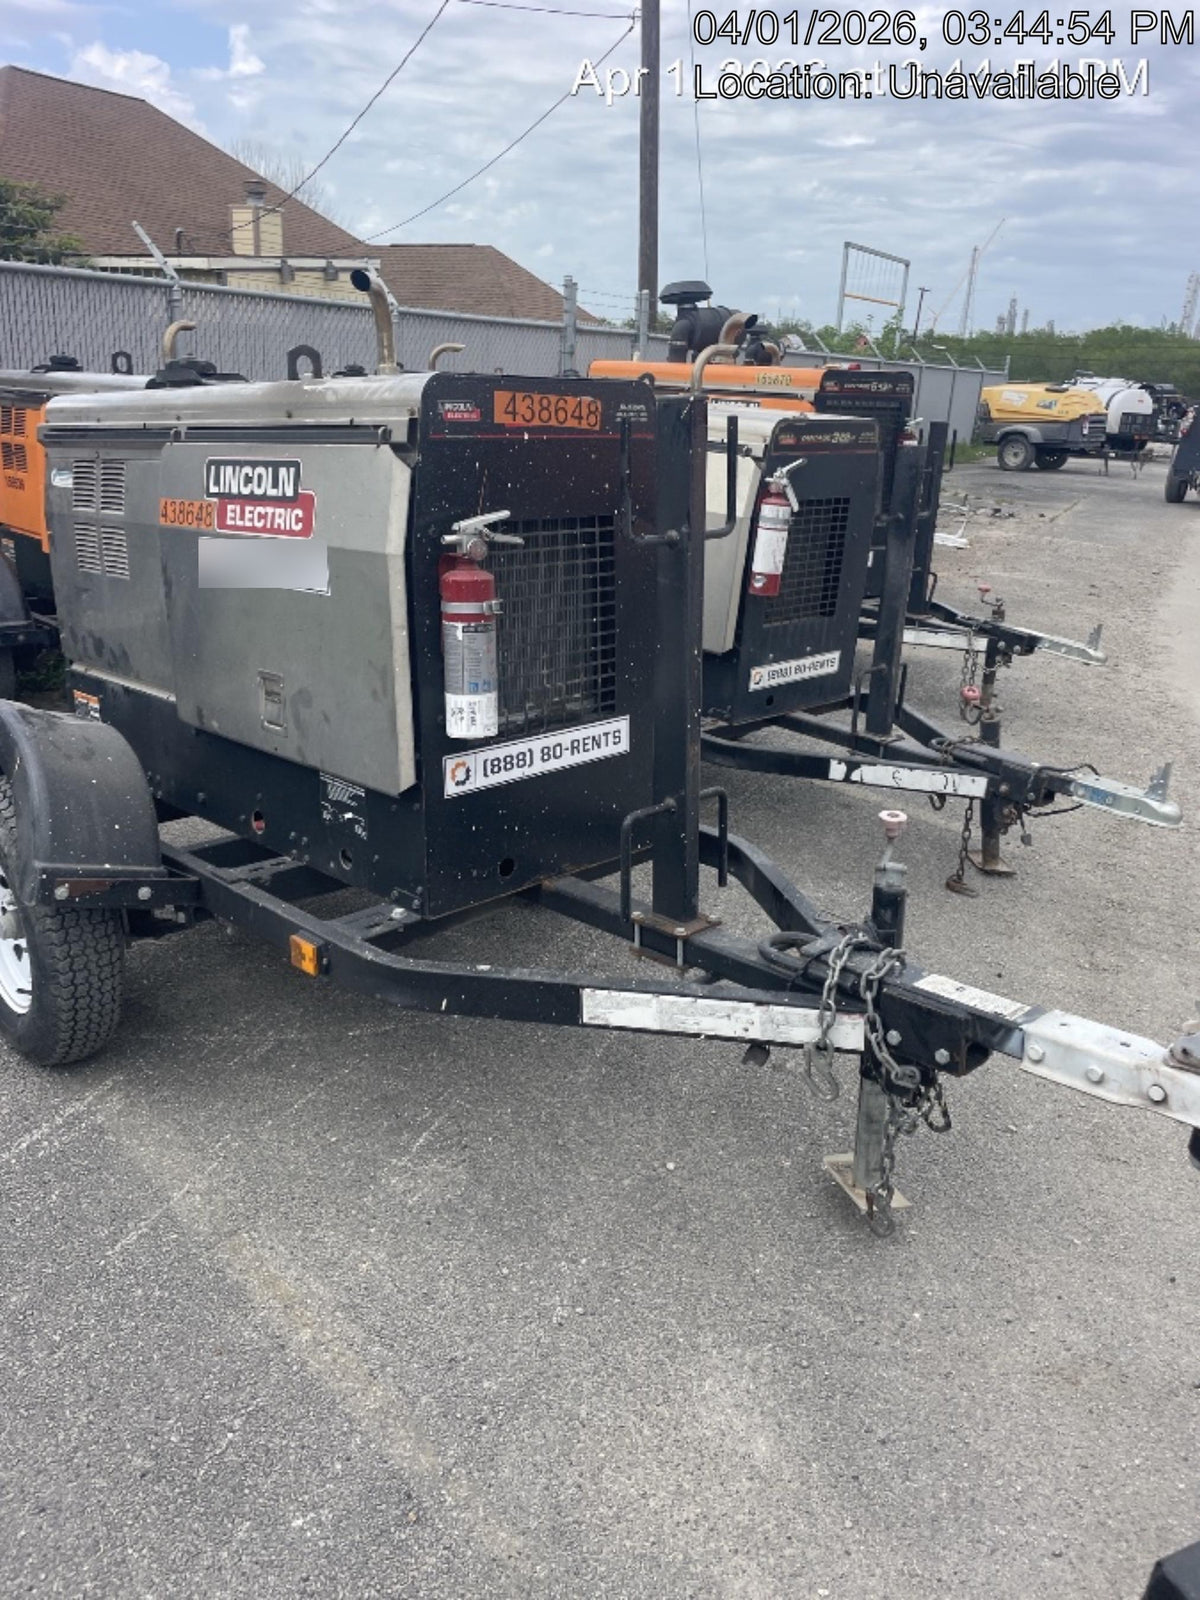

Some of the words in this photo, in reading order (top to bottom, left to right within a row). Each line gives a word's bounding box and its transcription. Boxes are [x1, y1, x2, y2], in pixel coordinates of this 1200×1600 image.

[503, 391, 599, 428] 438648
[208, 465, 296, 497] LINCOLN
[160, 500, 213, 529] 438648
[225, 504, 304, 531] ELECTRIC
[482, 748, 535, 778] (888)
[540, 729, 622, 763] 80-RENTS
